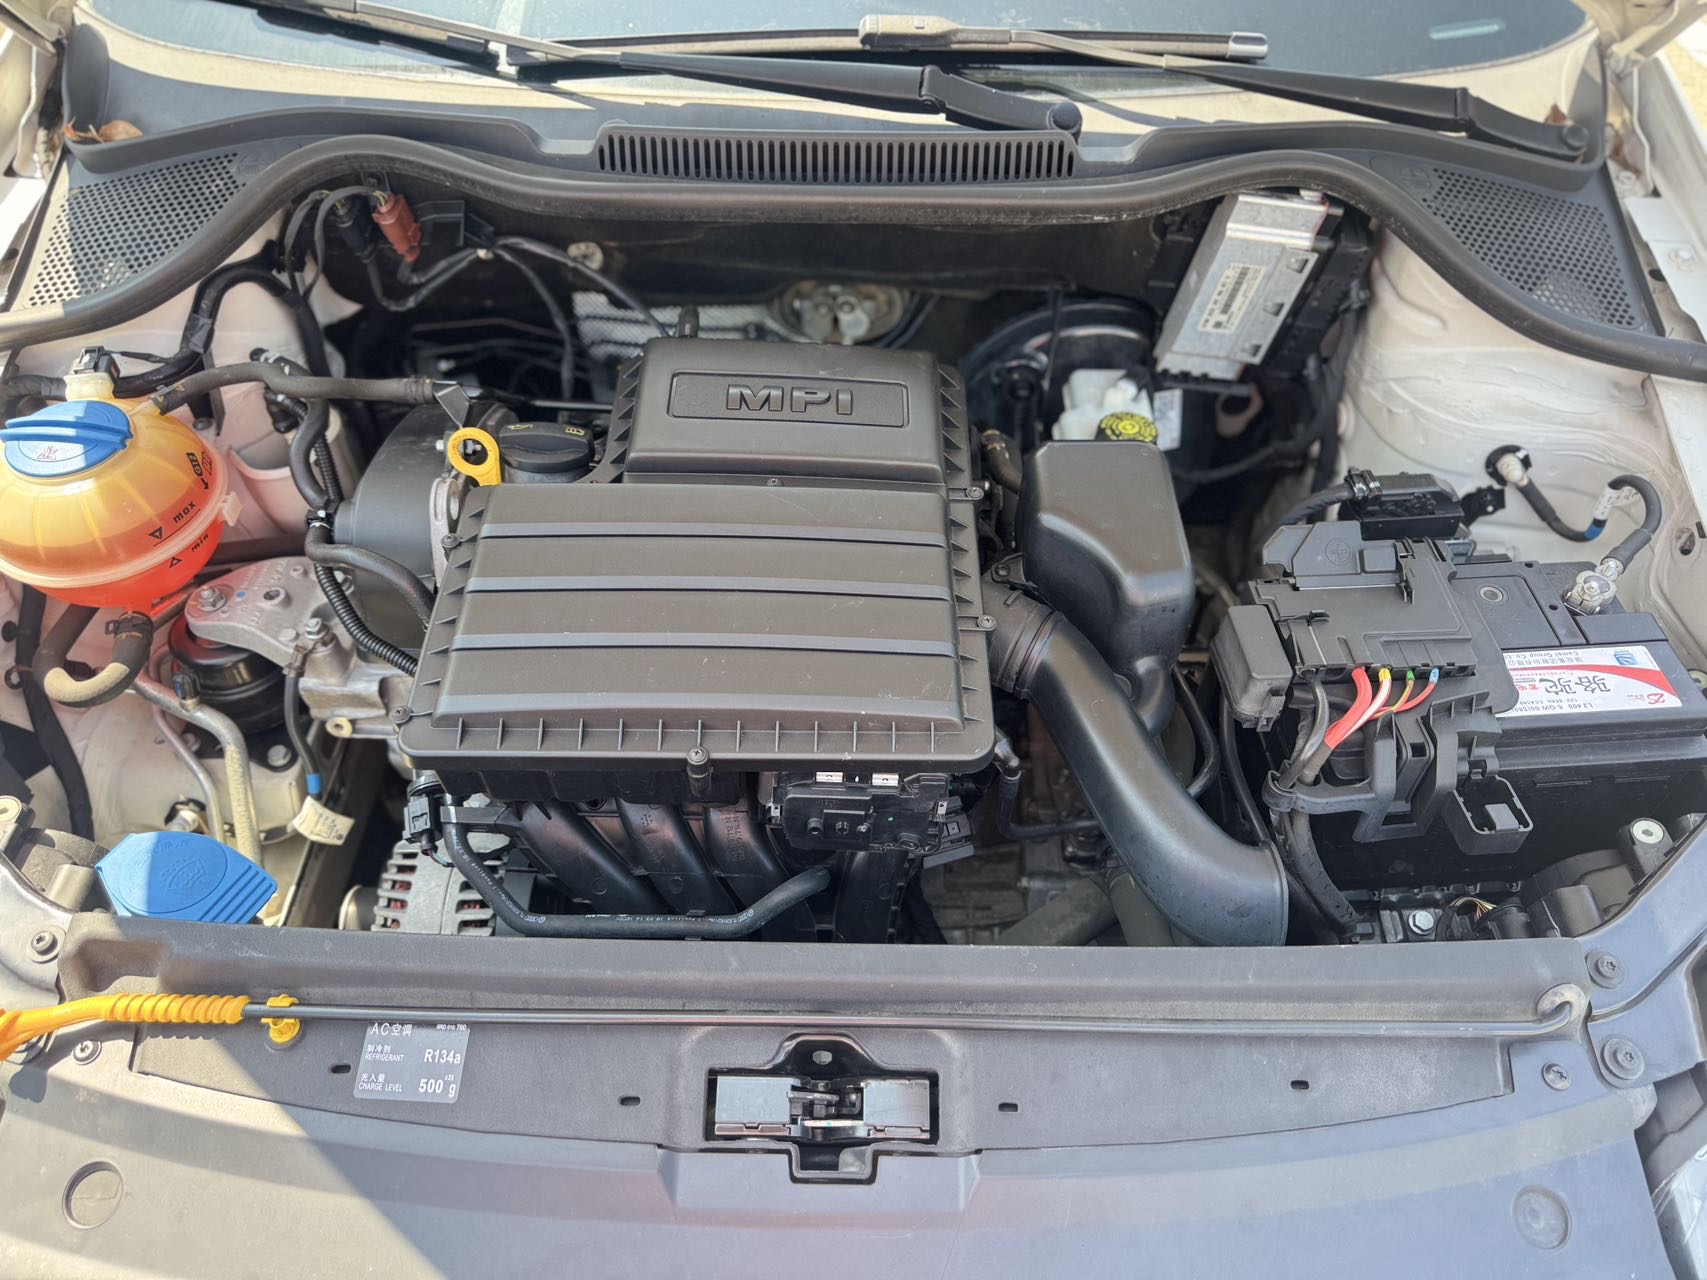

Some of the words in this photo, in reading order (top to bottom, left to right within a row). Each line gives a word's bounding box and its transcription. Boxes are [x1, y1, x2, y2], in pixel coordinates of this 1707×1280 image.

[726, 384, 852, 415] MPI
[173, 501, 196, 524] max
[191, 533, 209, 553] min
[1538, 675, 1611, 695] 骆驼
[371, 1023, 413, 1037] AC空调
[365, 1052, 404, 1062] REFRIGERANT
[424, 1049, 462, 1065] R134a
[361, 1073, 386, 1082] 充入量
[358, 1082, 383, 1091] CHARGE
[385, 1083, 402, 1092] LEVEL
[418, 1078, 444, 1094] 500
[448, 1083, 457, 1098] g
